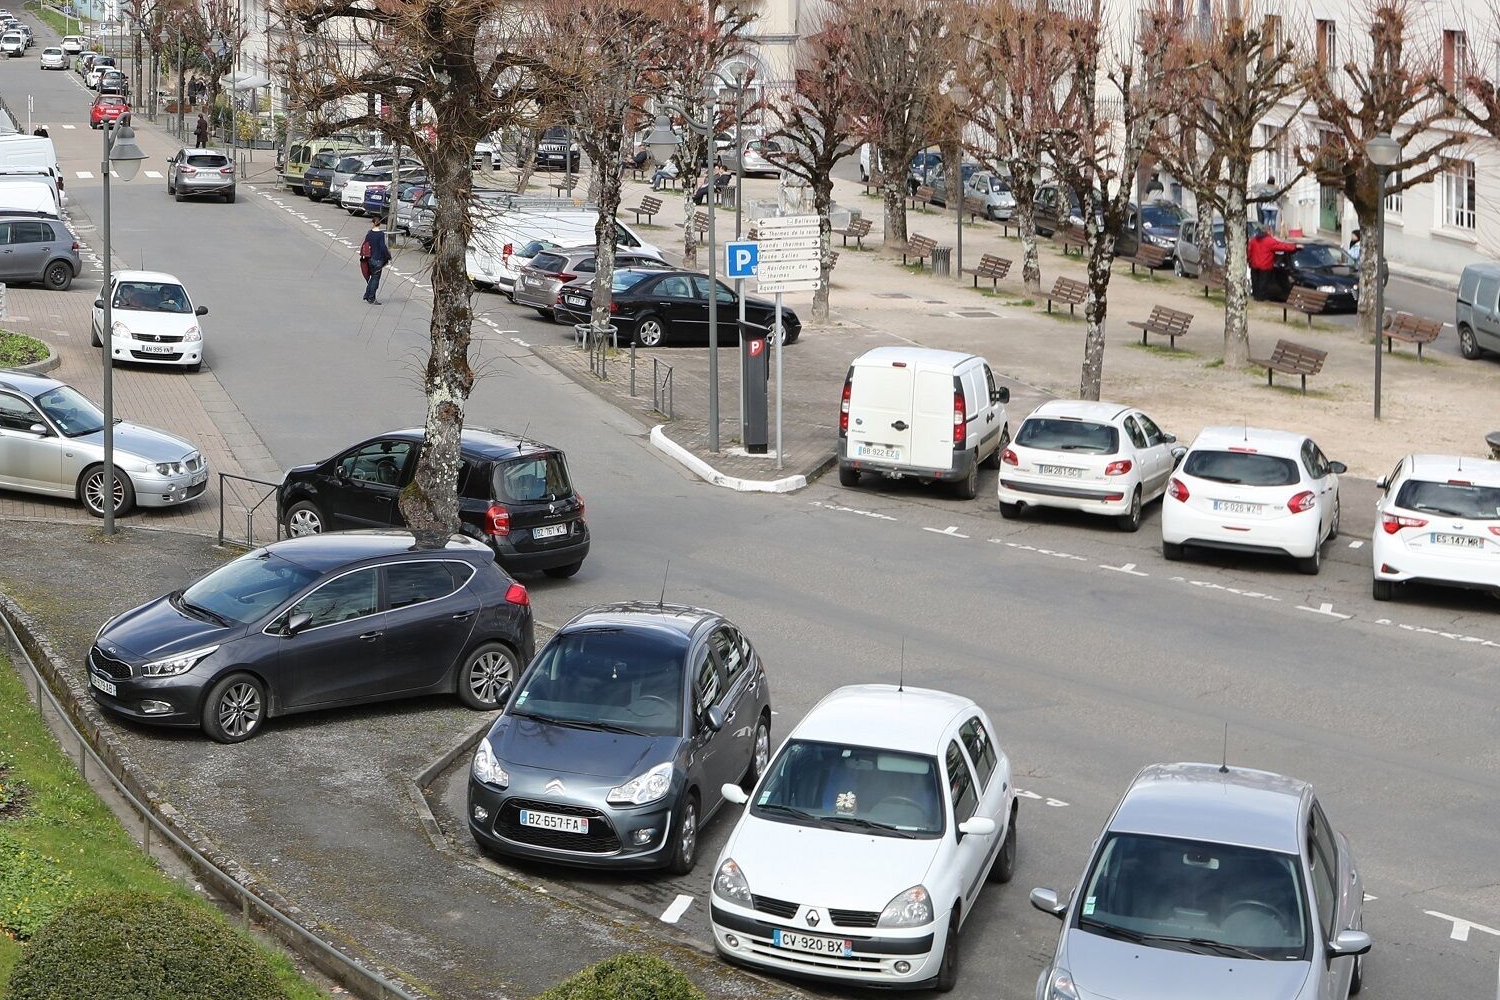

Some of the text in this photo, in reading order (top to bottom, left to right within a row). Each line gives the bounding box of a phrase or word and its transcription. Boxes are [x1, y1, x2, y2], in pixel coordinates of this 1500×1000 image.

[736, 249, 752, 272] P
[751, 341, 760, 354] P
[528, 813, 579, 831] BZ-657-FA
[782, 932, 843, 953] CV-920-BX
